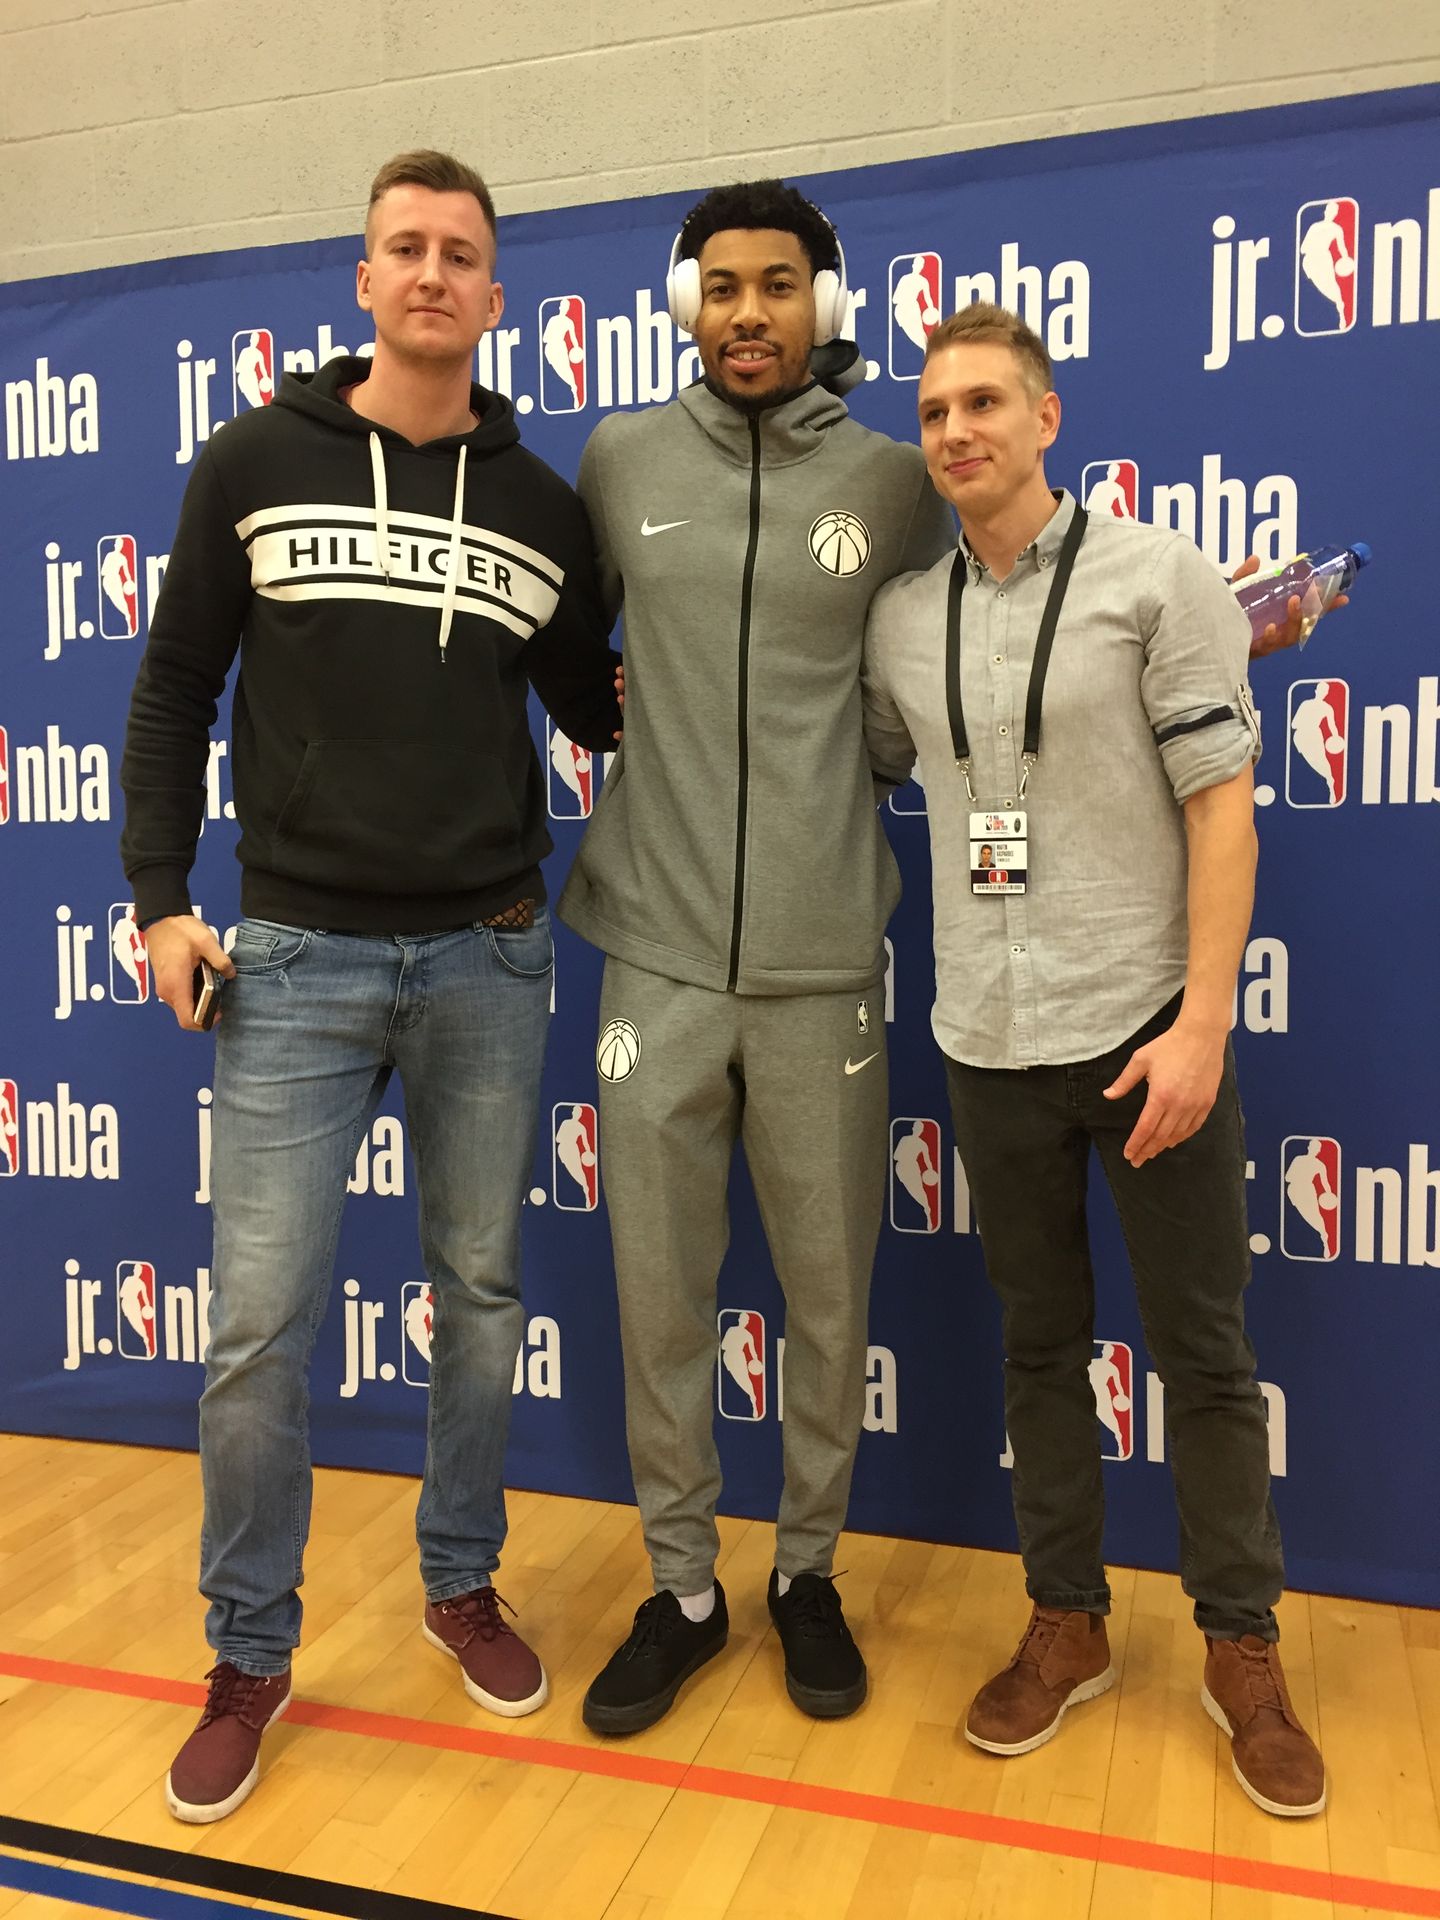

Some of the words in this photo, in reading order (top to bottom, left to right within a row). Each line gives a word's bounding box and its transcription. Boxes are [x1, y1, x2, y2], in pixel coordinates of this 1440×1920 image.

[1204, 215, 1286, 371] jr.
[4, 356, 100, 461] nba
[43, 541, 95, 661] jr.
[15, 724, 111, 823] nba
[54, 904, 106, 1020] jr.
[25, 1082, 120, 1180] nba
[63, 1258, 114, 1371] jr.
[340, 1278, 397, 1398] jr.
